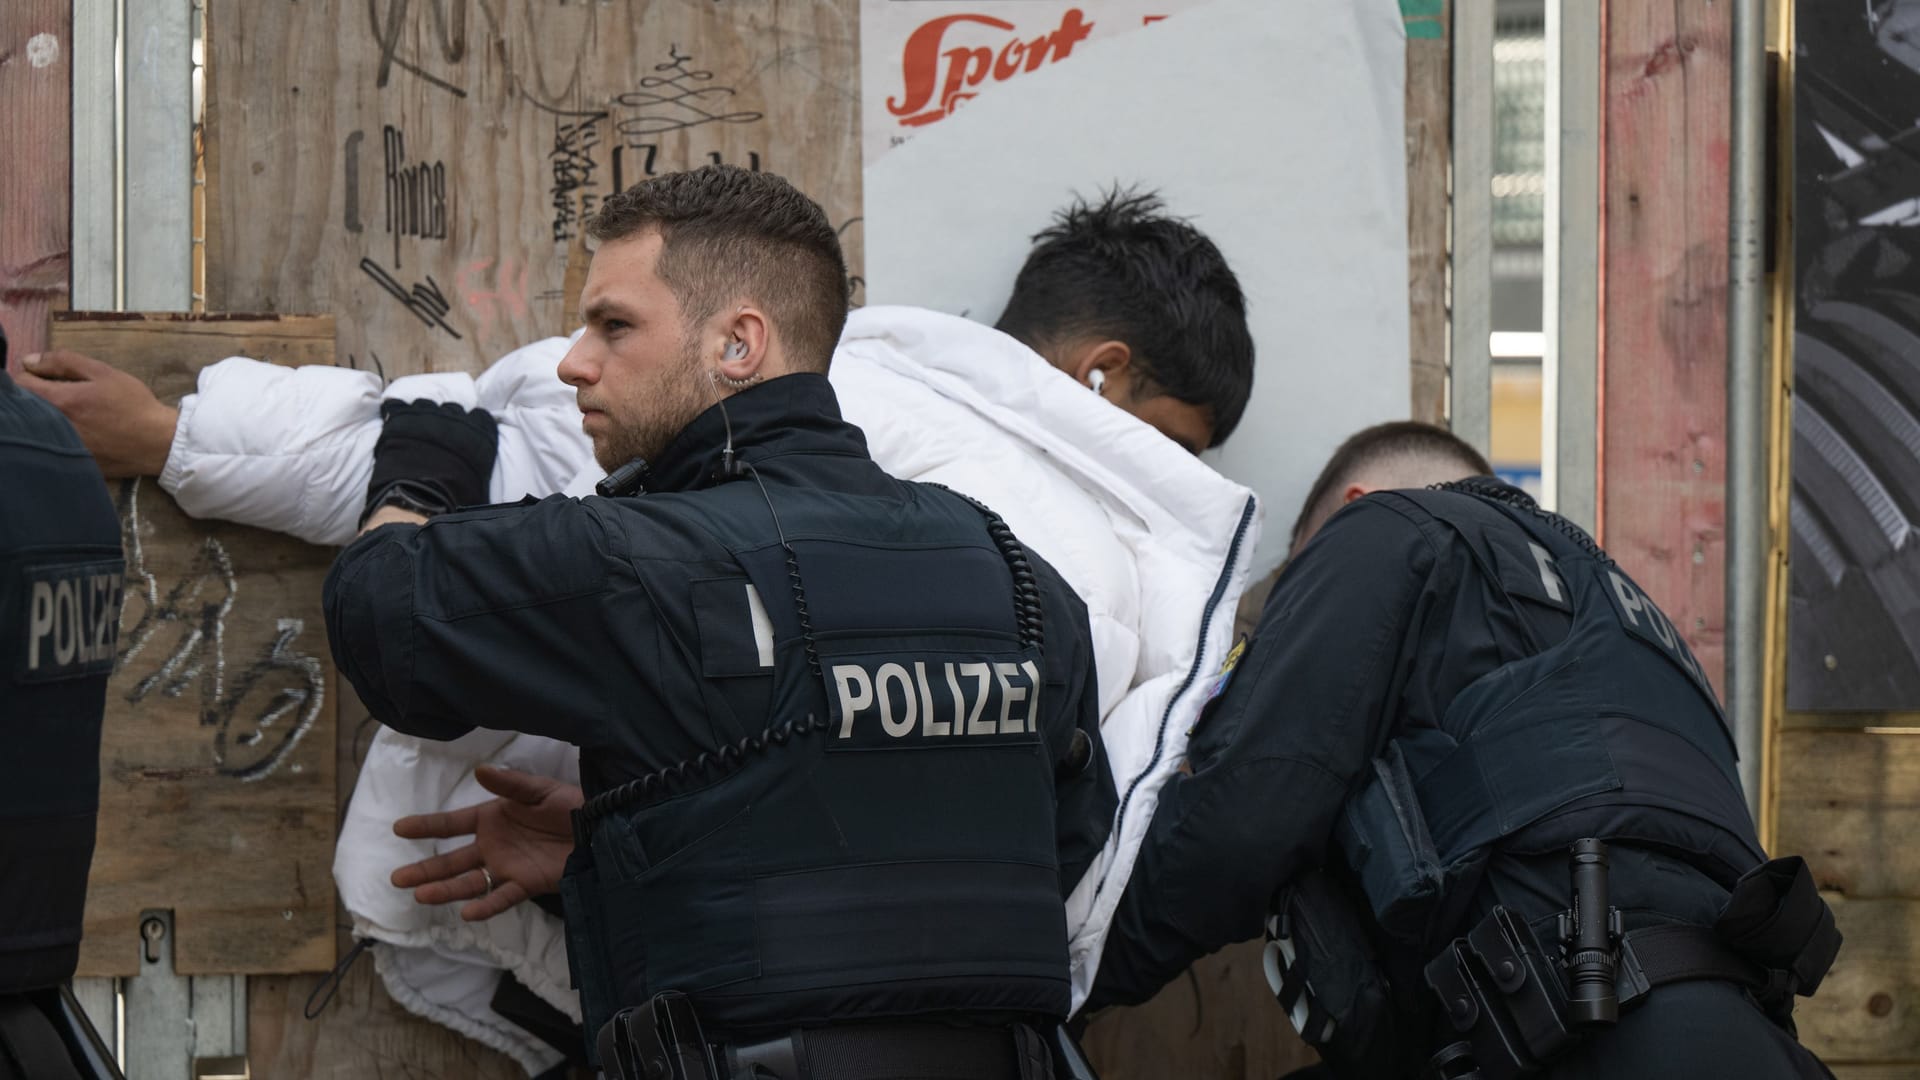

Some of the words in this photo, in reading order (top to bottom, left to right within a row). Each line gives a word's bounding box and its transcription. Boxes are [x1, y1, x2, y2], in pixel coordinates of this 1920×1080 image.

[886, 8, 1096, 117] Sport
[28, 574, 121, 669] POLIZE
[832, 660, 1040, 739] POLIZEI
